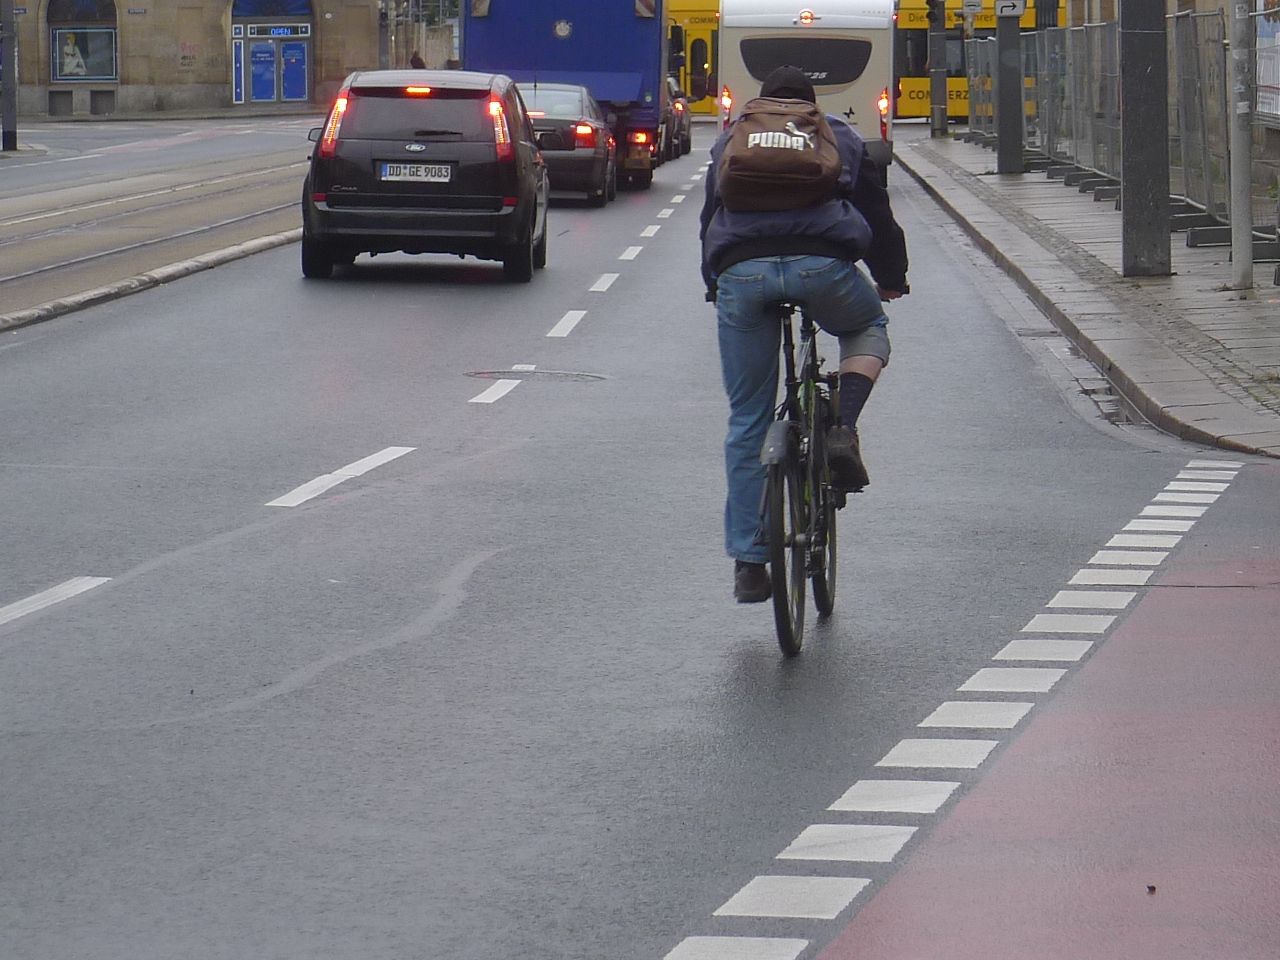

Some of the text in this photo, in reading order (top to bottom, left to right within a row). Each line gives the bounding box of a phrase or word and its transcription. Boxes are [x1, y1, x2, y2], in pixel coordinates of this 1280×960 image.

[270, 28, 291, 36] OPEN
[748, 132, 805, 151] PUMA
[388, 165, 450, 178] DD GE 9083
